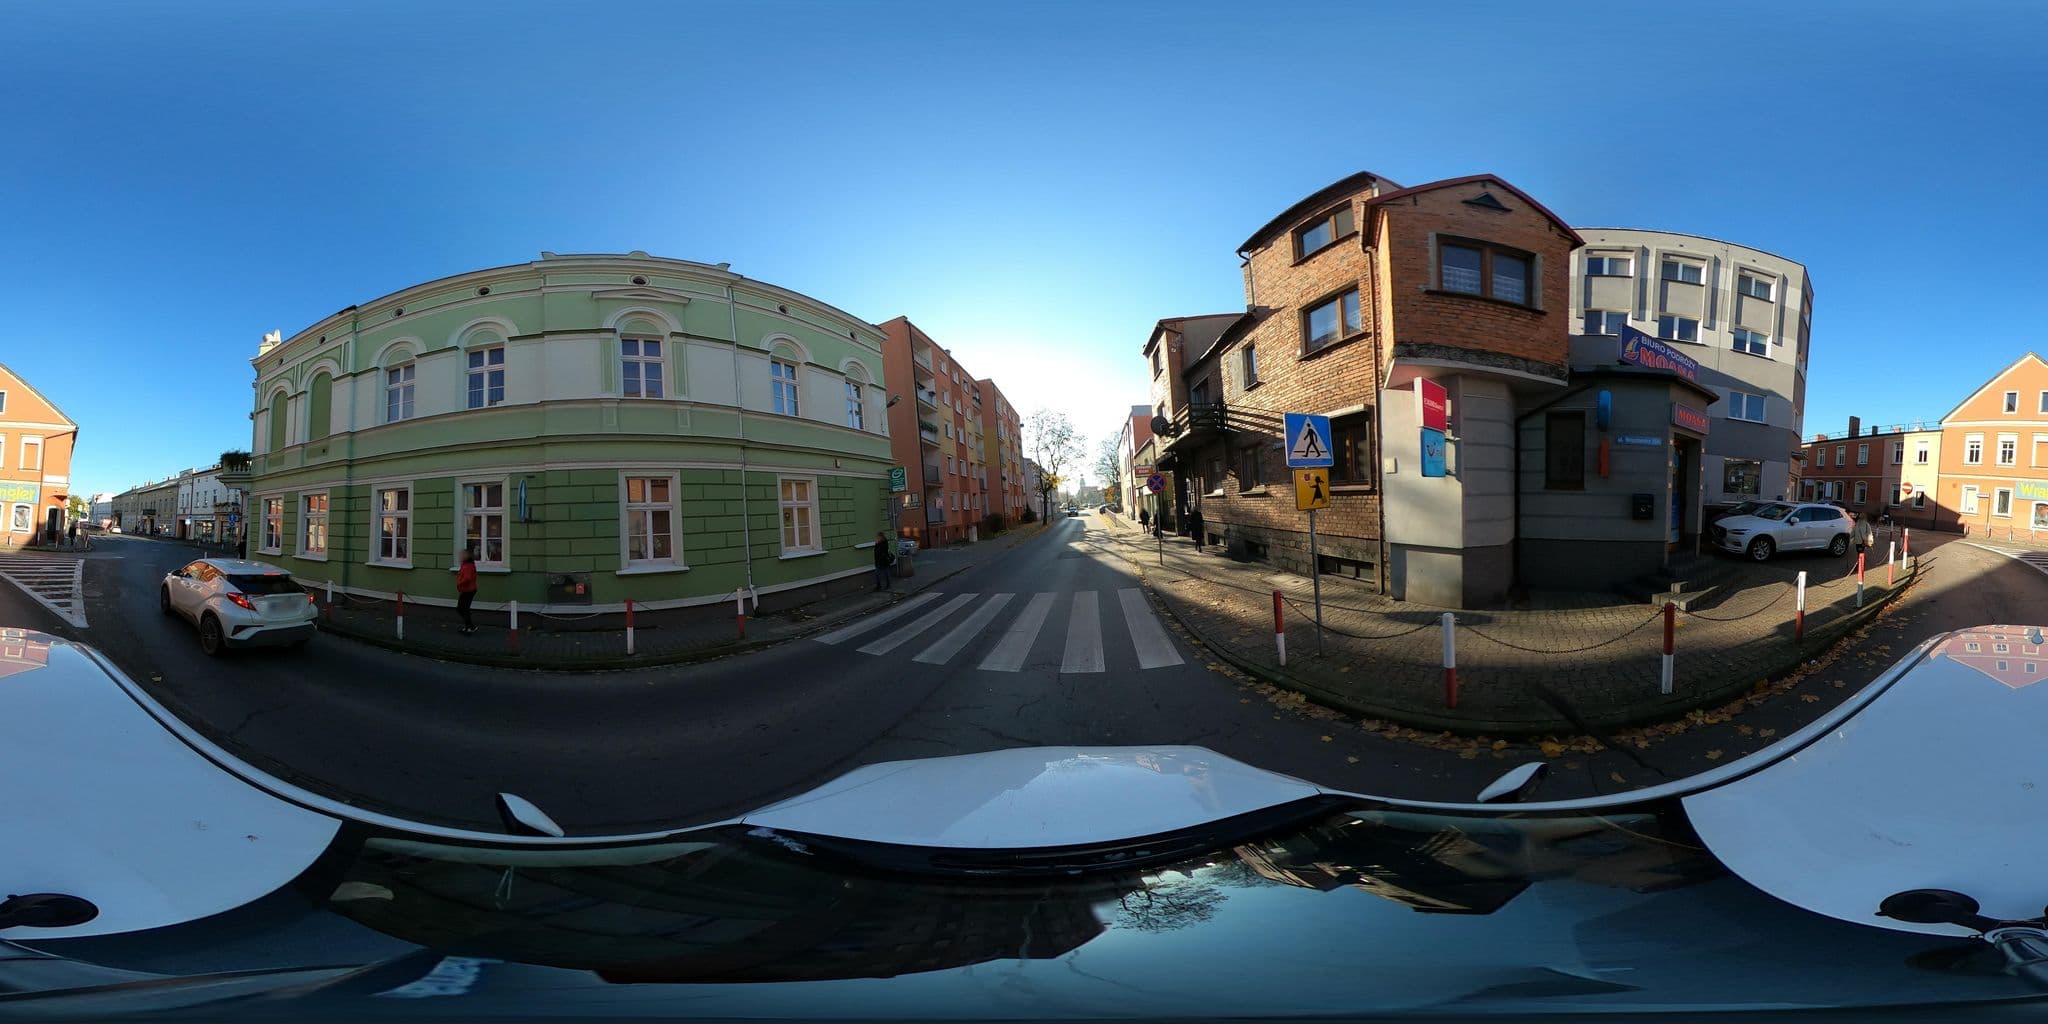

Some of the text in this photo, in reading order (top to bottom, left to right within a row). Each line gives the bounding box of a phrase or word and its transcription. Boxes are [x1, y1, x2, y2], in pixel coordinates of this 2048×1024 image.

[1641, 336, 1665, 353] BIURO
[1640, 346, 1695, 382] MOANA
[1679, 409, 1706, 428] MOANA
